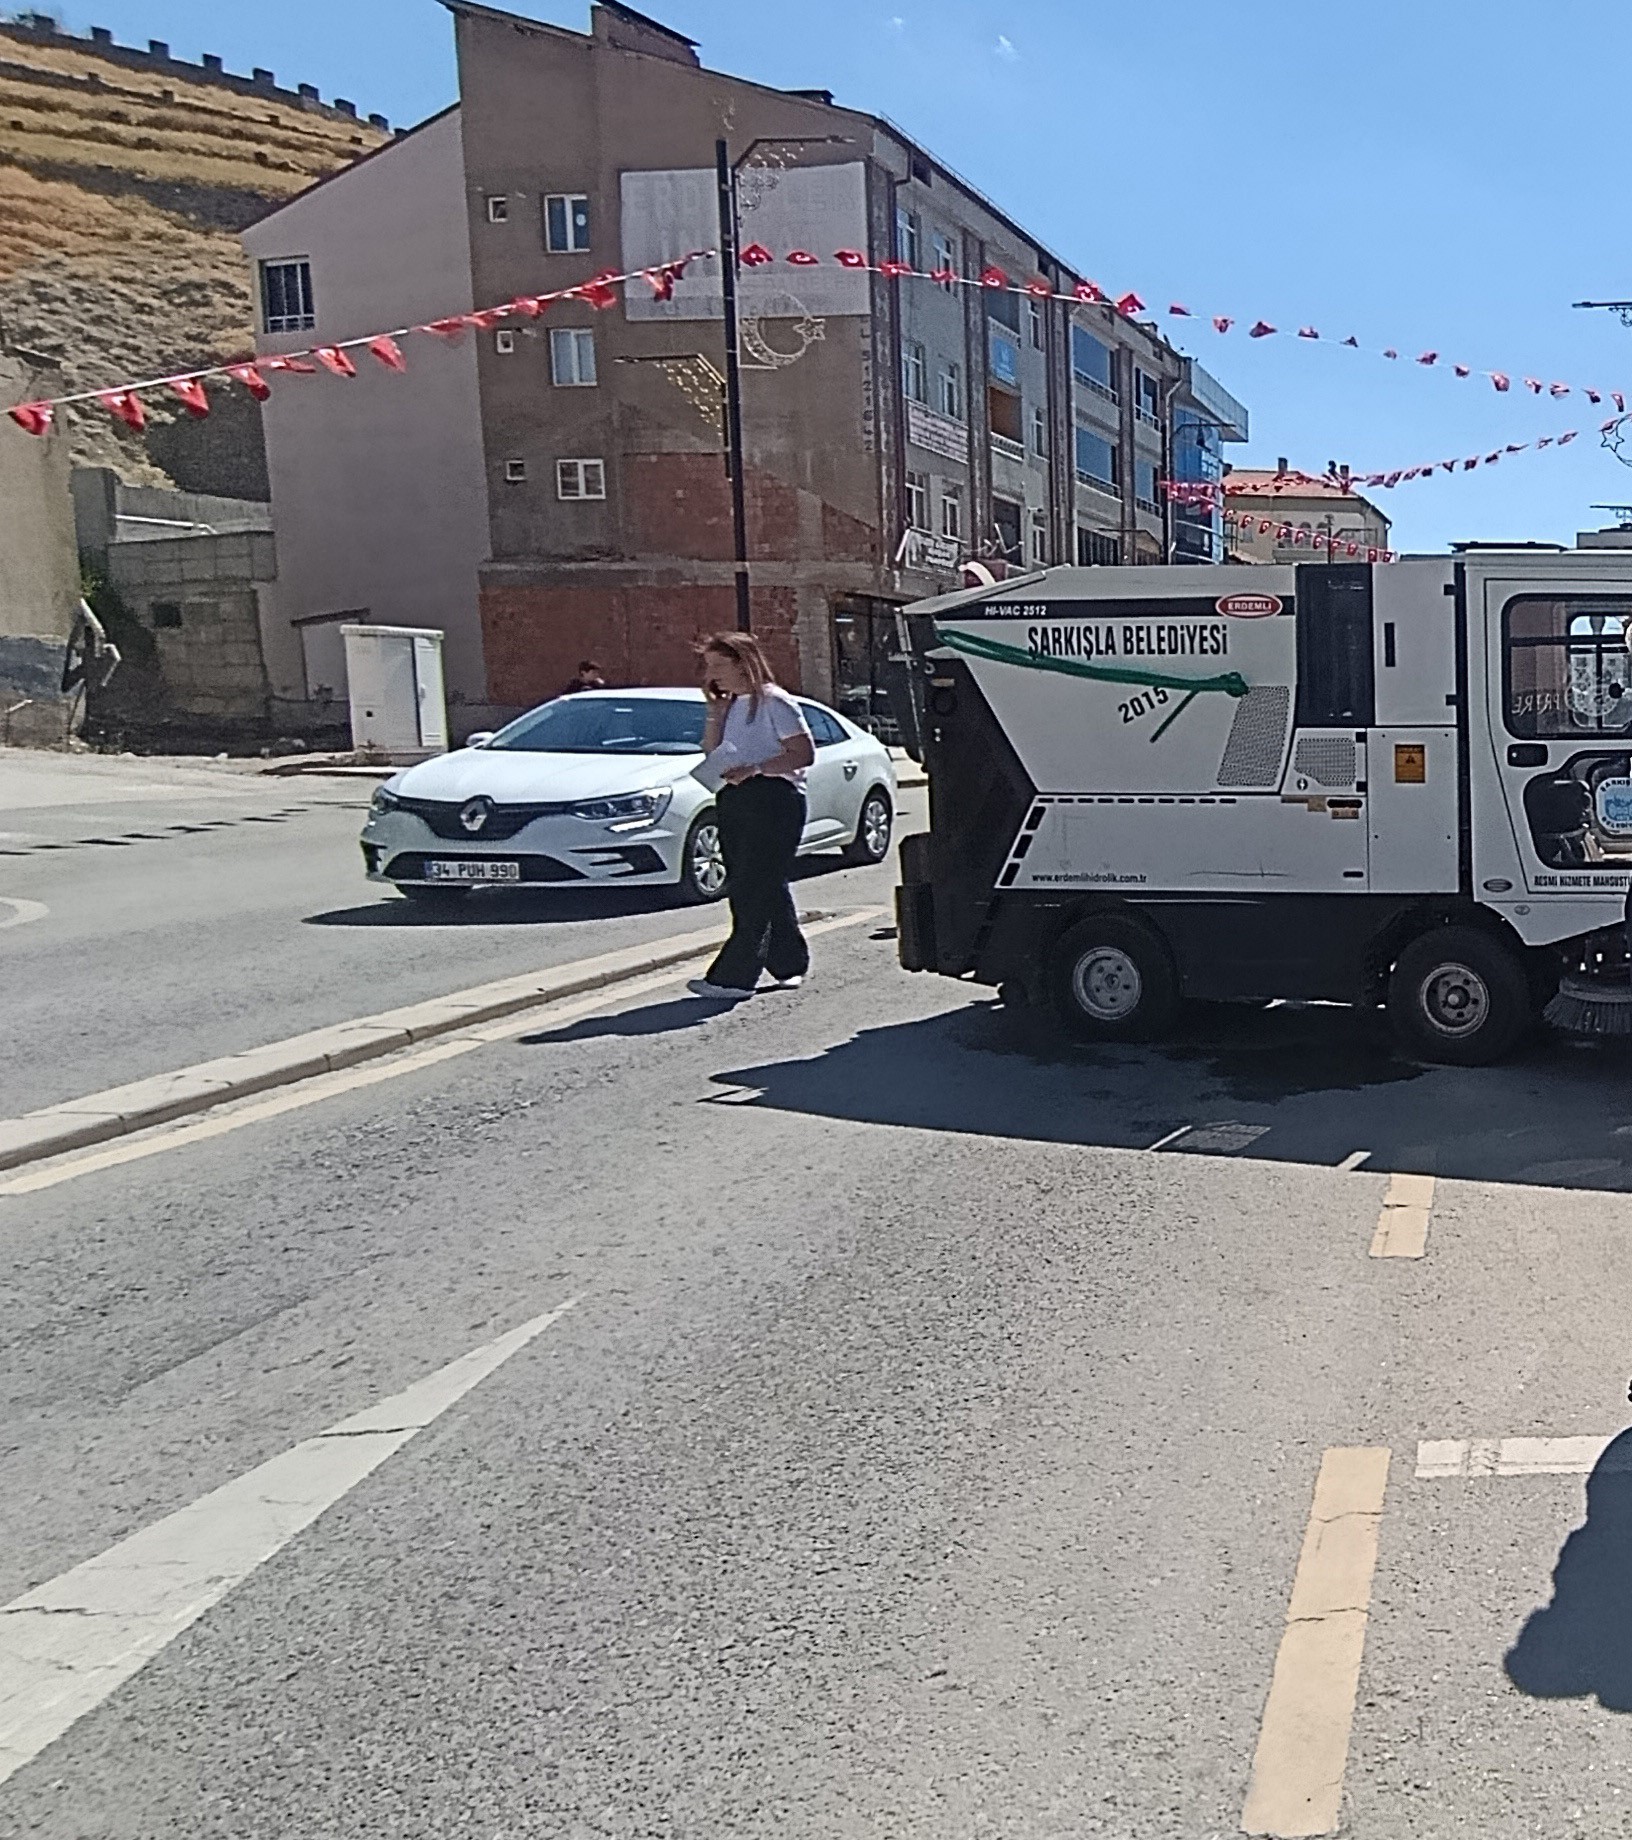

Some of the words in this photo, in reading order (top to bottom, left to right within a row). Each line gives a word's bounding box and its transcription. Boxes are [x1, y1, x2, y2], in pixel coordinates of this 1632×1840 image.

[1023, 605, 1047, 616] 2512
[1028, 626, 1117, 662] ŞARKIŞLA
[1122, 624, 1229, 656] BELEDİYESİ
[1117, 685, 1170, 725] 2015
[432, 862, 450, 877] 34
